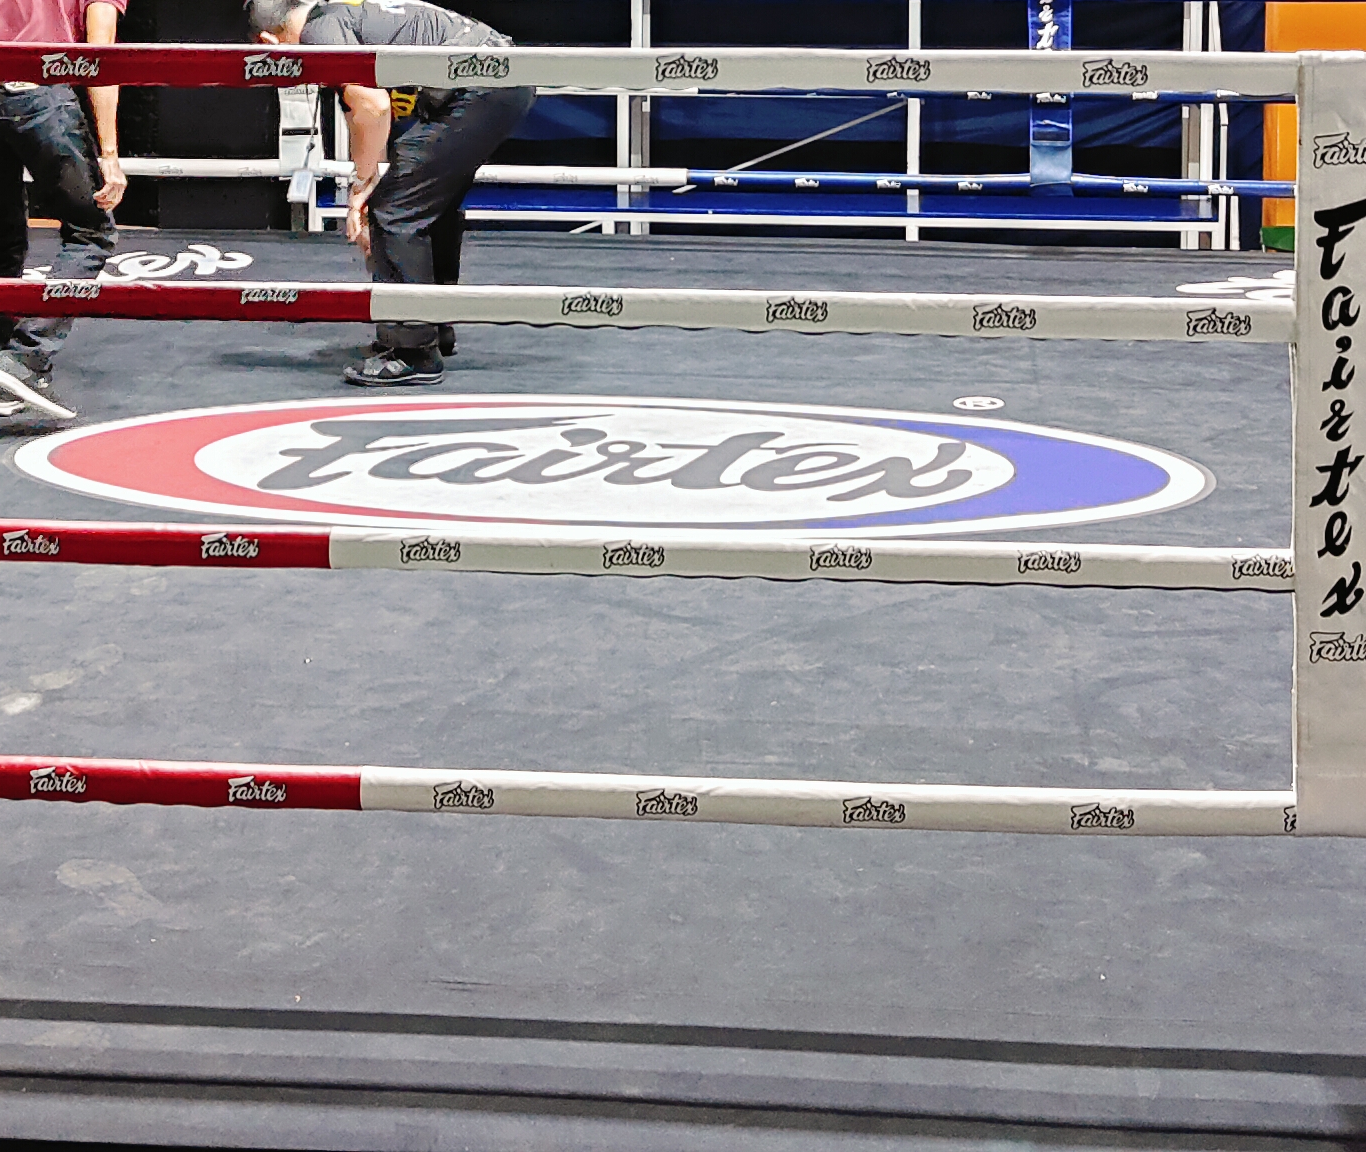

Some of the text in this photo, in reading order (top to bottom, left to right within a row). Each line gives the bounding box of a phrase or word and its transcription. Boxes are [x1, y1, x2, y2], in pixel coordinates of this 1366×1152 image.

[41, 53, 100, 78] Fairtex
[244, 54, 302, 79] Fairtex
[448, 53, 509, 79] Fairtex
[656, 55, 718, 80] Fairtex
[867, 57, 930, 83] Fairtex
[1083, 59, 1148, 87] Fairtex
[562, 291, 623, 316] Fairtex
[766, 297, 828, 322] Fairtex
[973, 304, 1036, 330] Fairtex
[1187, 309, 1251, 336] Fairtex
[257, 414, 972, 501] Fairtex
[2, 530, 59, 555] Fairtex
[200, 534, 259, 559] Fairtex
[401, 538, 460, 563] Fairtex
[603, 542, 664, 568] Fairtex
[810, 545, 872, 570] Fairtex
[1017, 550, 1081, 576] Fairtex
[29, 766, 87, 794] Fairtex
[228, 775, 286, 802] Fairtex
[434, 782, 493, 809] Fairtex
[636, 789, 697, 816] Fairtex
[843, 797, 905, 823] Fairtex
[1071, 803, 1134, 830] Fairtex
